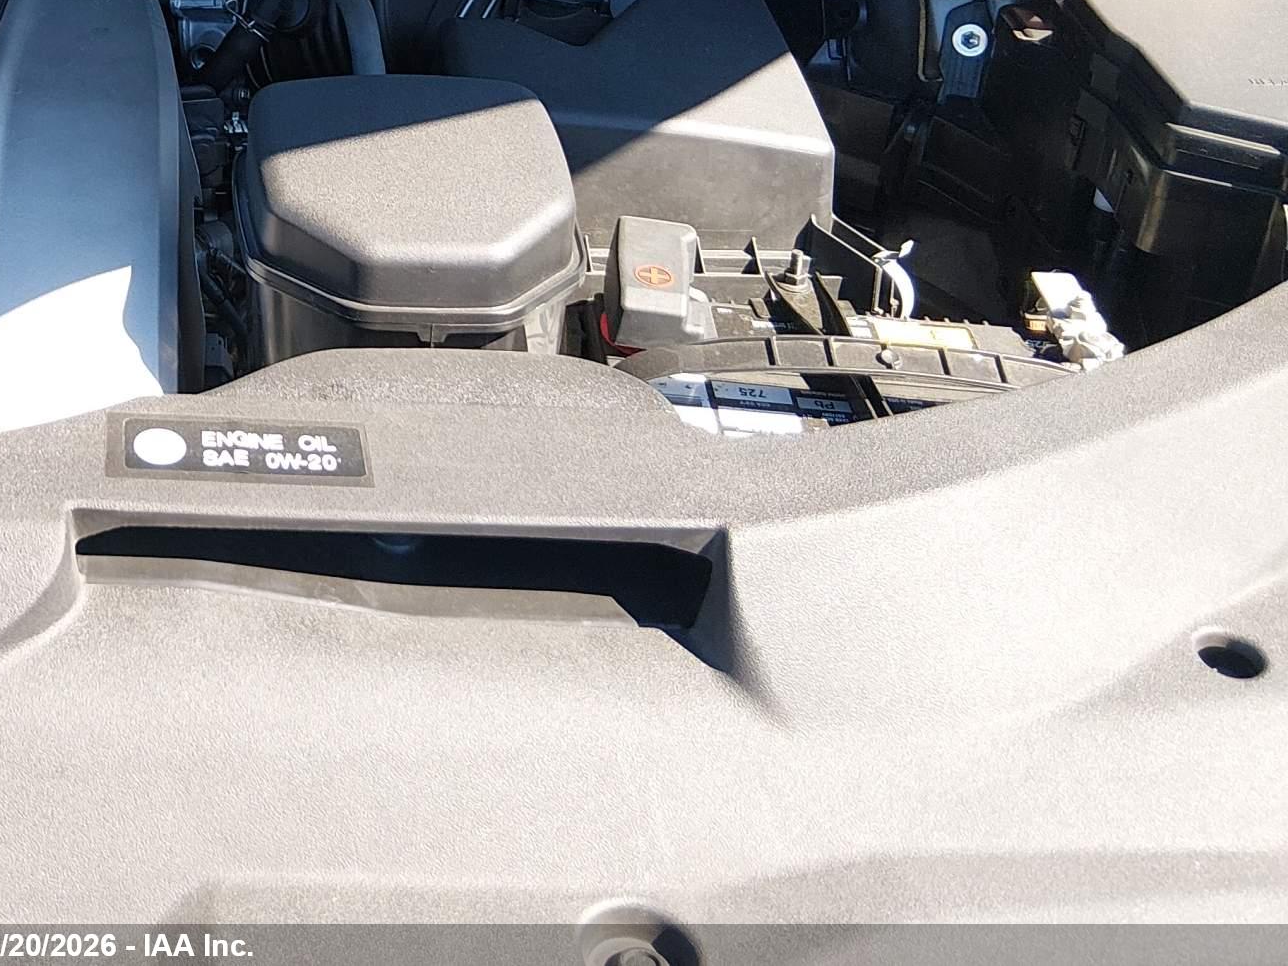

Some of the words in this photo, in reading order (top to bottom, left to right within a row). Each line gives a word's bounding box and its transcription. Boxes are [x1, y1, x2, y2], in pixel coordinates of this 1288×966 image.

[738, 387, 767, 399] 725
[814, 400, 836, 410] Pb
[201, 430, 284, 451] ENGINE
[298, 434, 337, 453] OIL
[202, 449, 250, 467] SAE
[265, 452, 338, 471] 0W-20
